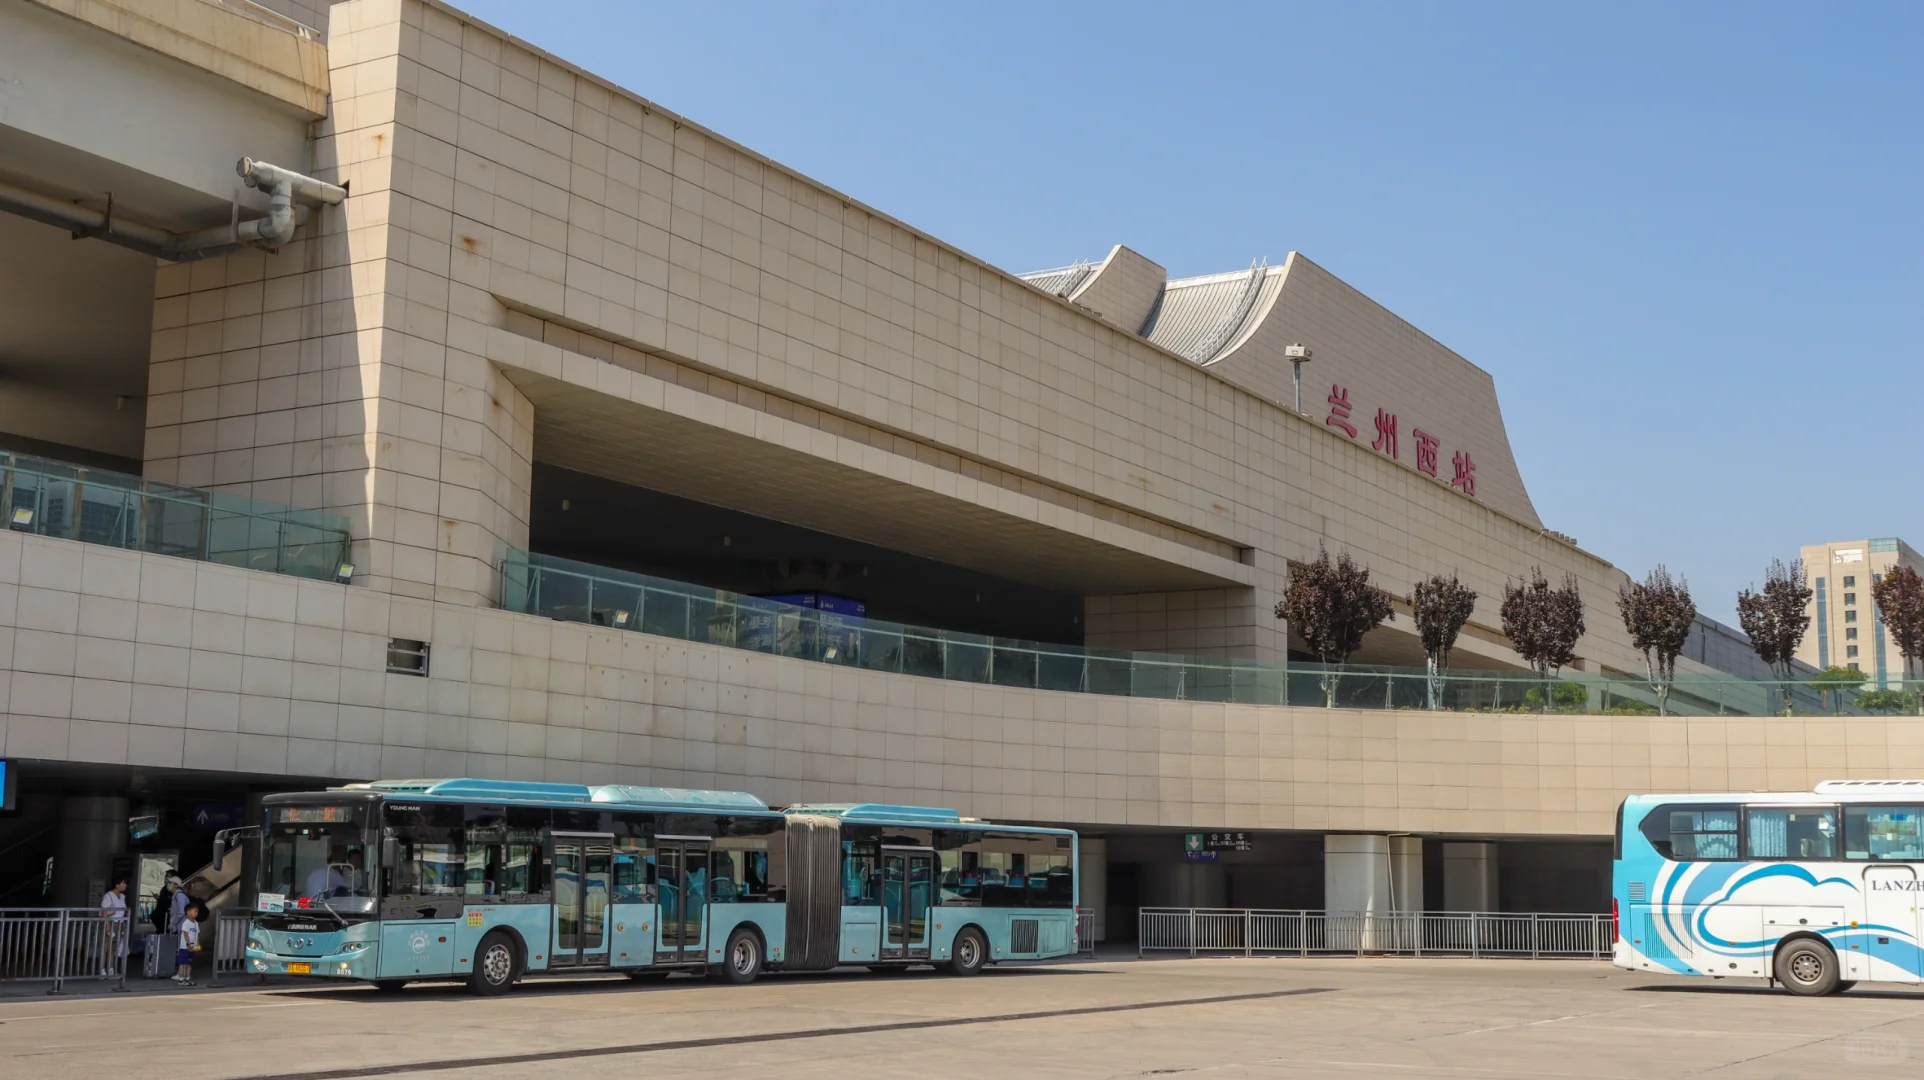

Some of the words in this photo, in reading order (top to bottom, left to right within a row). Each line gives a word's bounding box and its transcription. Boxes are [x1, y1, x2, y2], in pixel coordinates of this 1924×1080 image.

[1326, 384, 1477, 497] 兰州西站
[1872, 880, 1924, 891] LANZH
